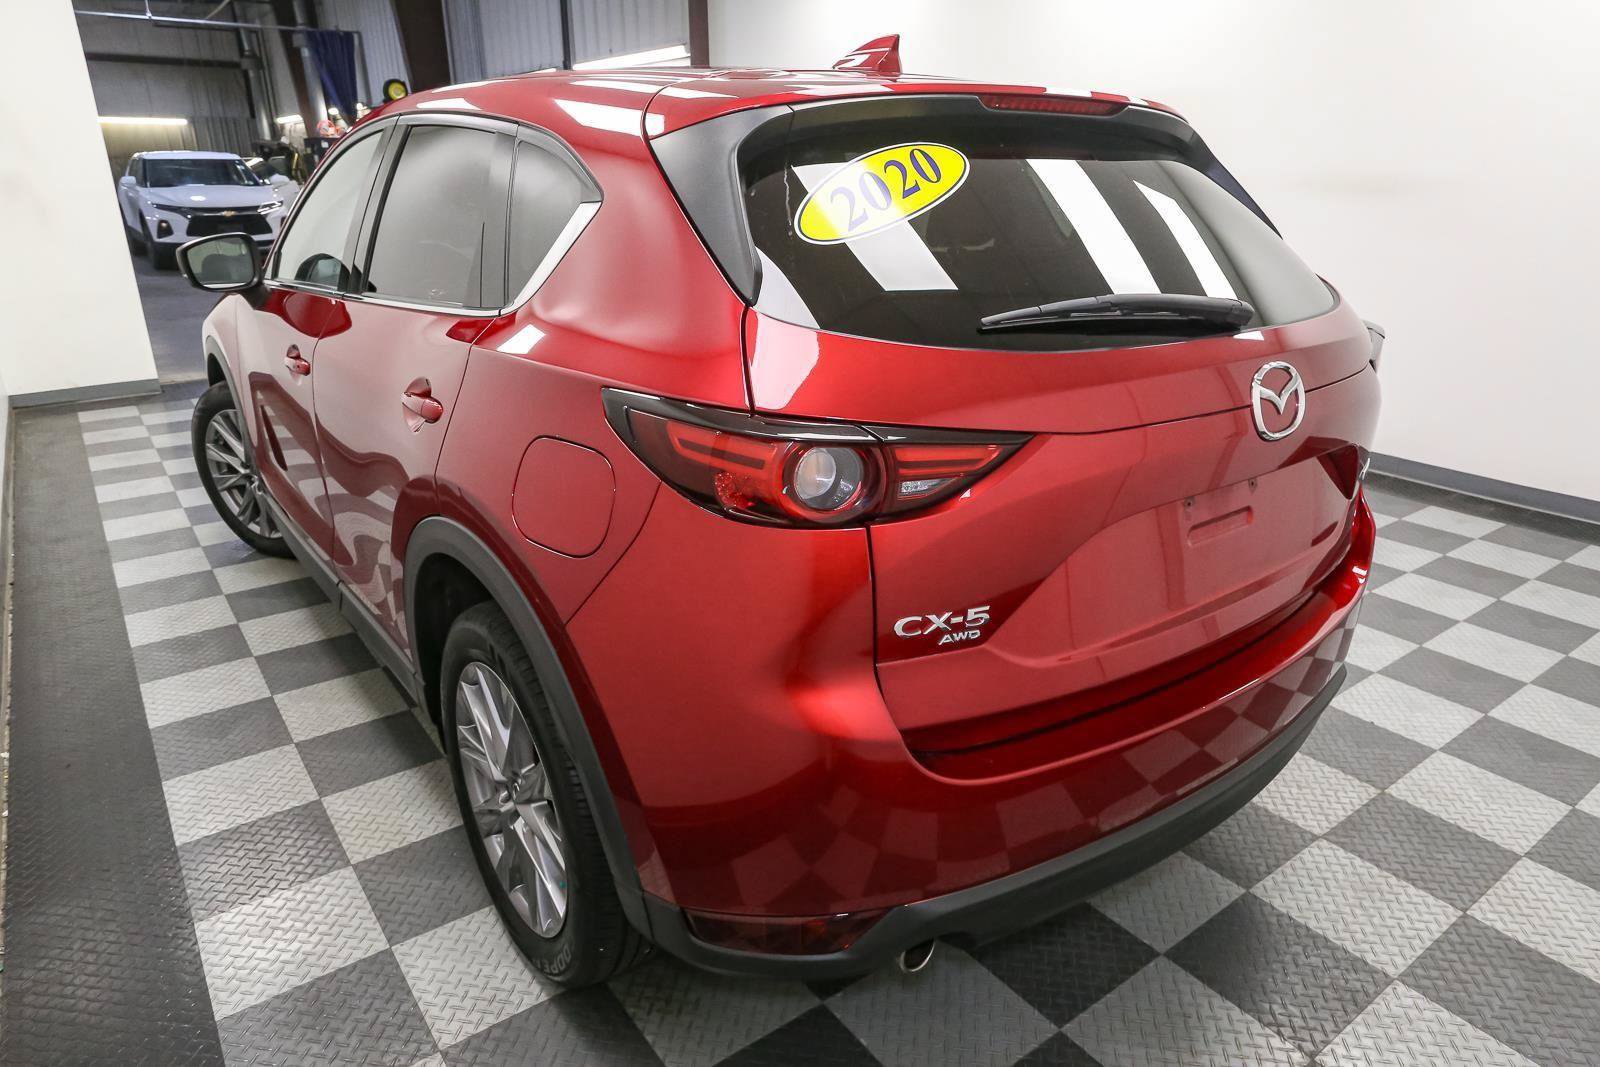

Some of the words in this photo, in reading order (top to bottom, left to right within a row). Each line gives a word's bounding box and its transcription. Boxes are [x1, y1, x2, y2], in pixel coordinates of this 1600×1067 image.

[830, 148, 942, 232] 2020
[893, 605, 991, 637] CX-5
[938, 629, 981, 646] AWD
